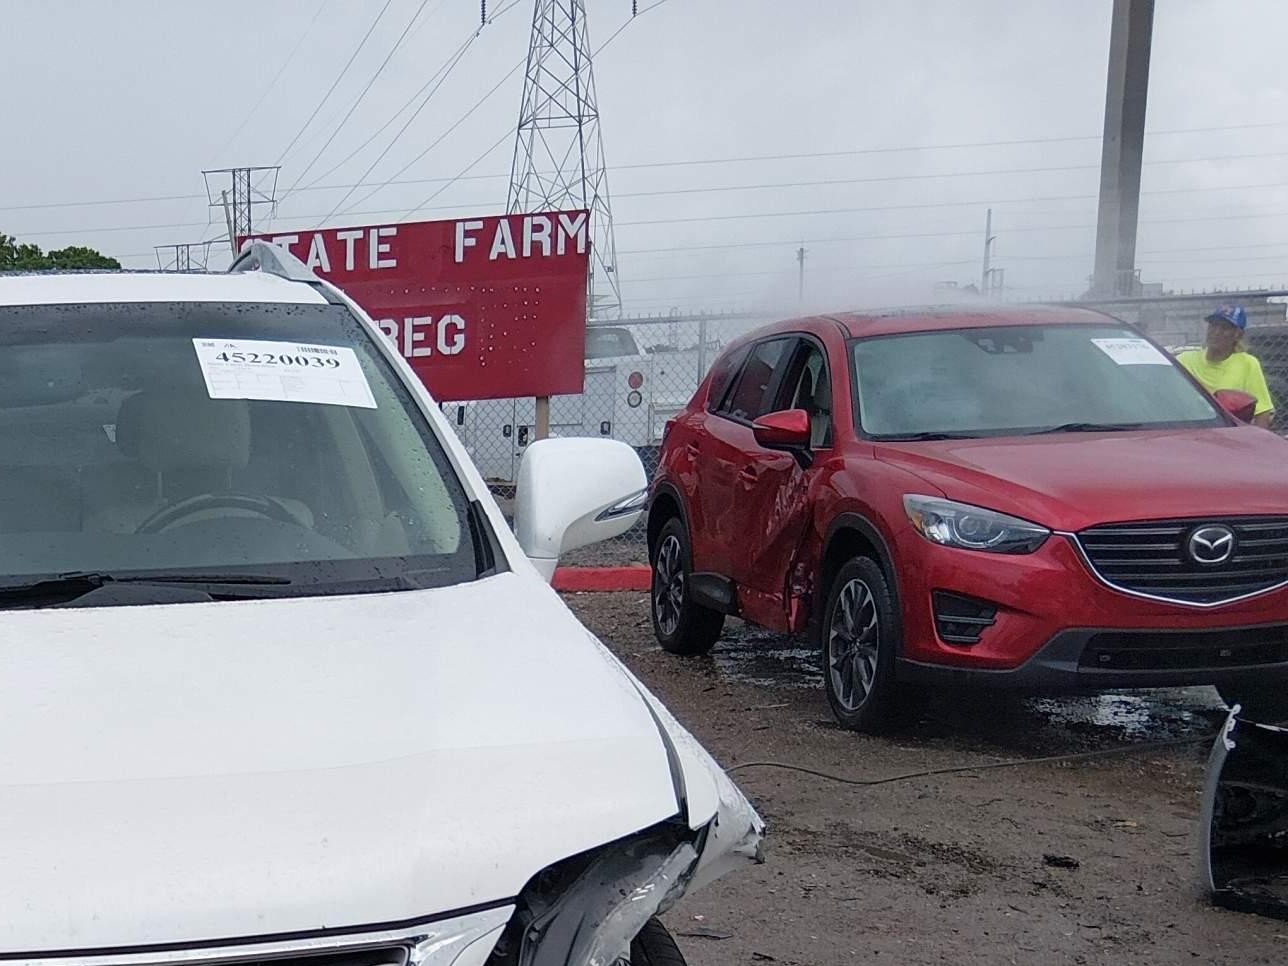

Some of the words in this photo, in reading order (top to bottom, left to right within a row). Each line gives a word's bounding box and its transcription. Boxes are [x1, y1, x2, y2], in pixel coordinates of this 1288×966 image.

[240, 228, 398, 272] TATE
[454, 213, 587, 263] FARM
[215, 352, 340, 368] 45220039
